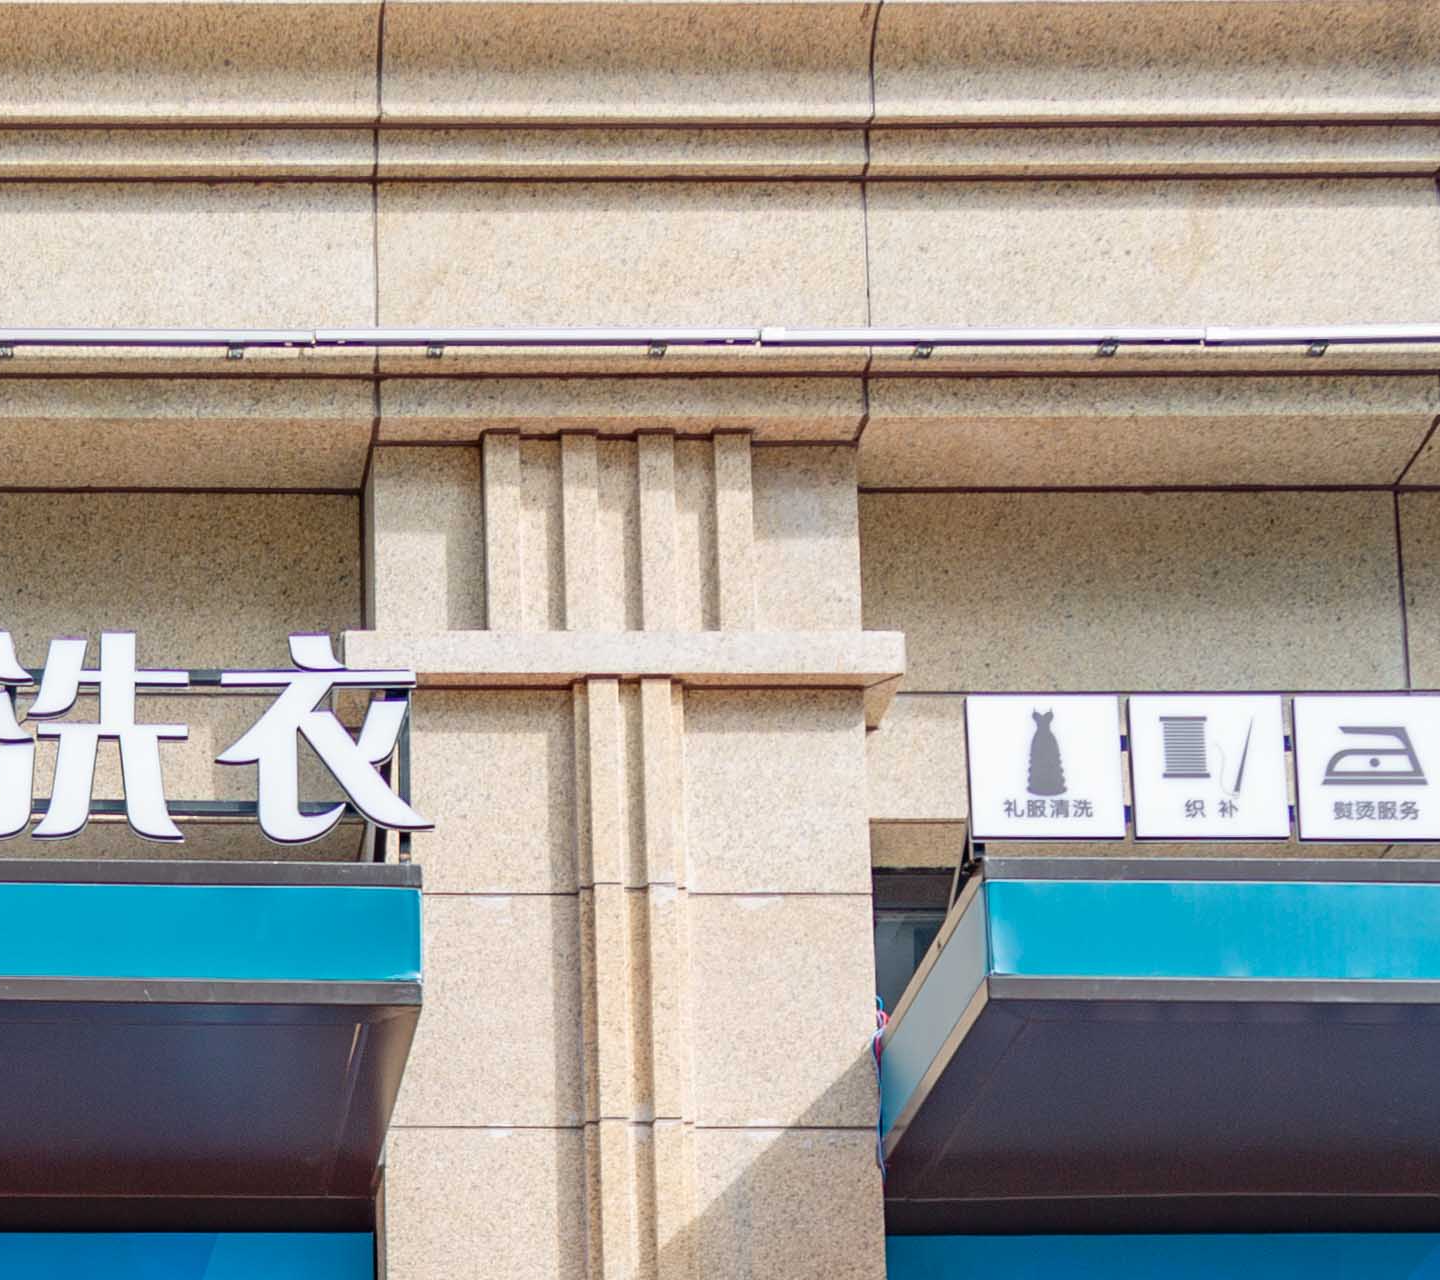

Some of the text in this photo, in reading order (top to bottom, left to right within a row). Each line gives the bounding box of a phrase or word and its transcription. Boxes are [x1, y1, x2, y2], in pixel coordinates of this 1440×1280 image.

[1003, 799, 1094, 819] 礼服清洗
[1333, 801, 1420, 821] 熨烫服务
